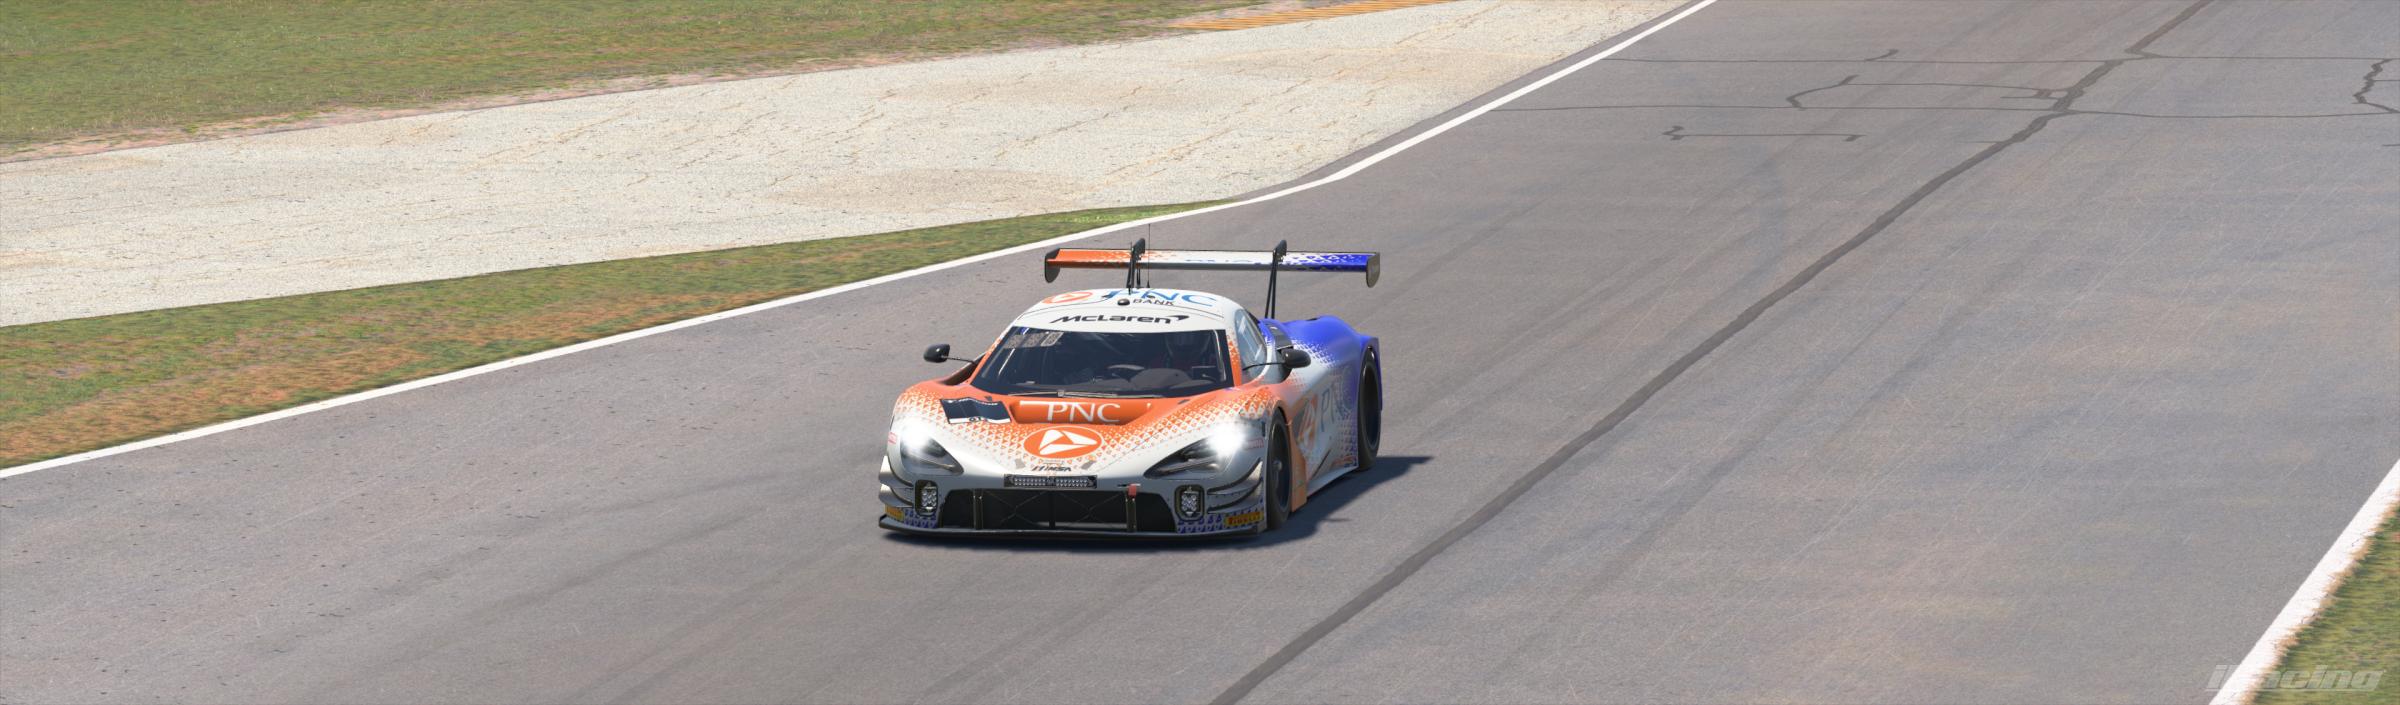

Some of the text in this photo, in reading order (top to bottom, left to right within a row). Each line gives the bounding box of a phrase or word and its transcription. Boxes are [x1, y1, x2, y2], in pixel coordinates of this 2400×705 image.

[1132, 298, 1176, 306] BANK
[1050, 314, 1172, 324] McLaren
[1047, 402, 1121, 422] PNC
